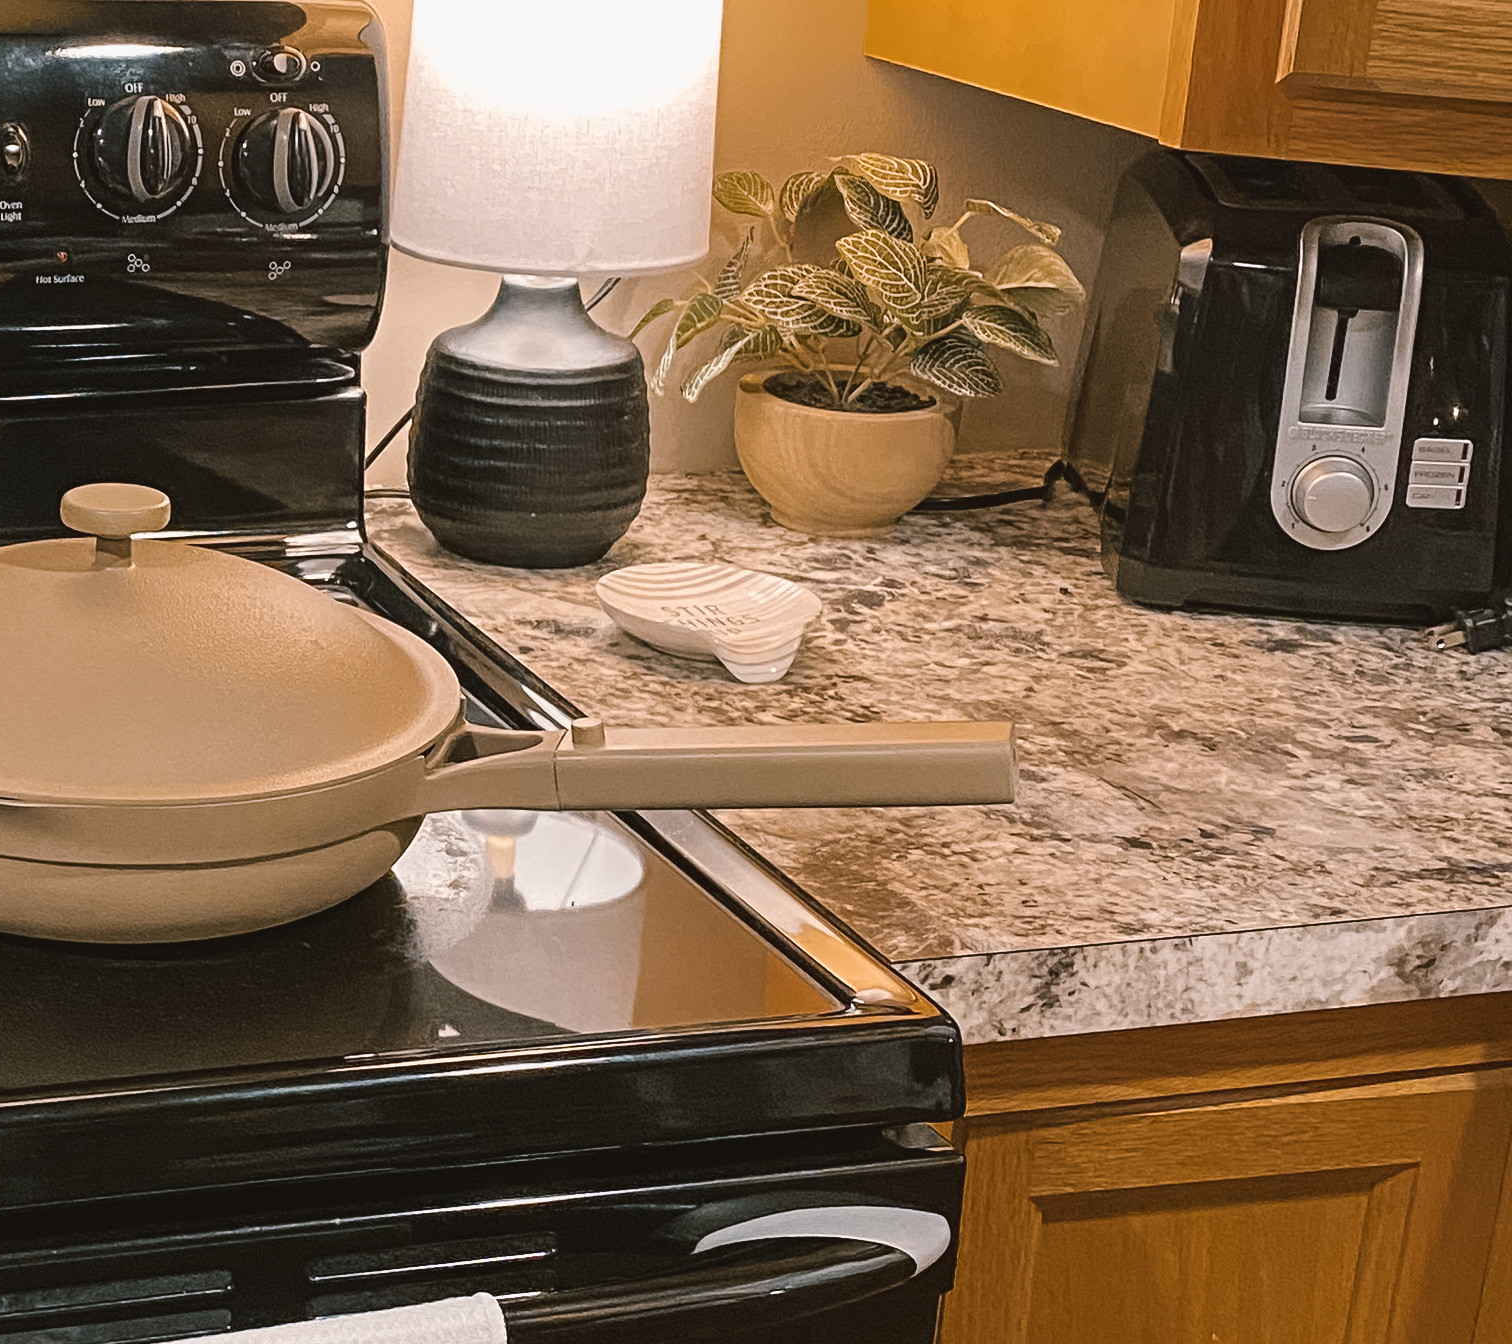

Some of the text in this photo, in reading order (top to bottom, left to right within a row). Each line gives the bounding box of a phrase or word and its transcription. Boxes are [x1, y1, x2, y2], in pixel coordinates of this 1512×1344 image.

[88, 97, 106, 107] Low
[165, 93, 186, 104] High
[270, 92, 288, 103] OFF
[234, 107, 251, 116] Low
[309, 103, 329, 113] High
[225, 127, 231, 137] 2
[0, 200, 23, 210] Oven
[0, 211, 22, 223] Light
[35, 273, 85, 284] Hot Surface
[660, 604, 726, 617] STIR
[678, 615, 760, 628] HINGS
